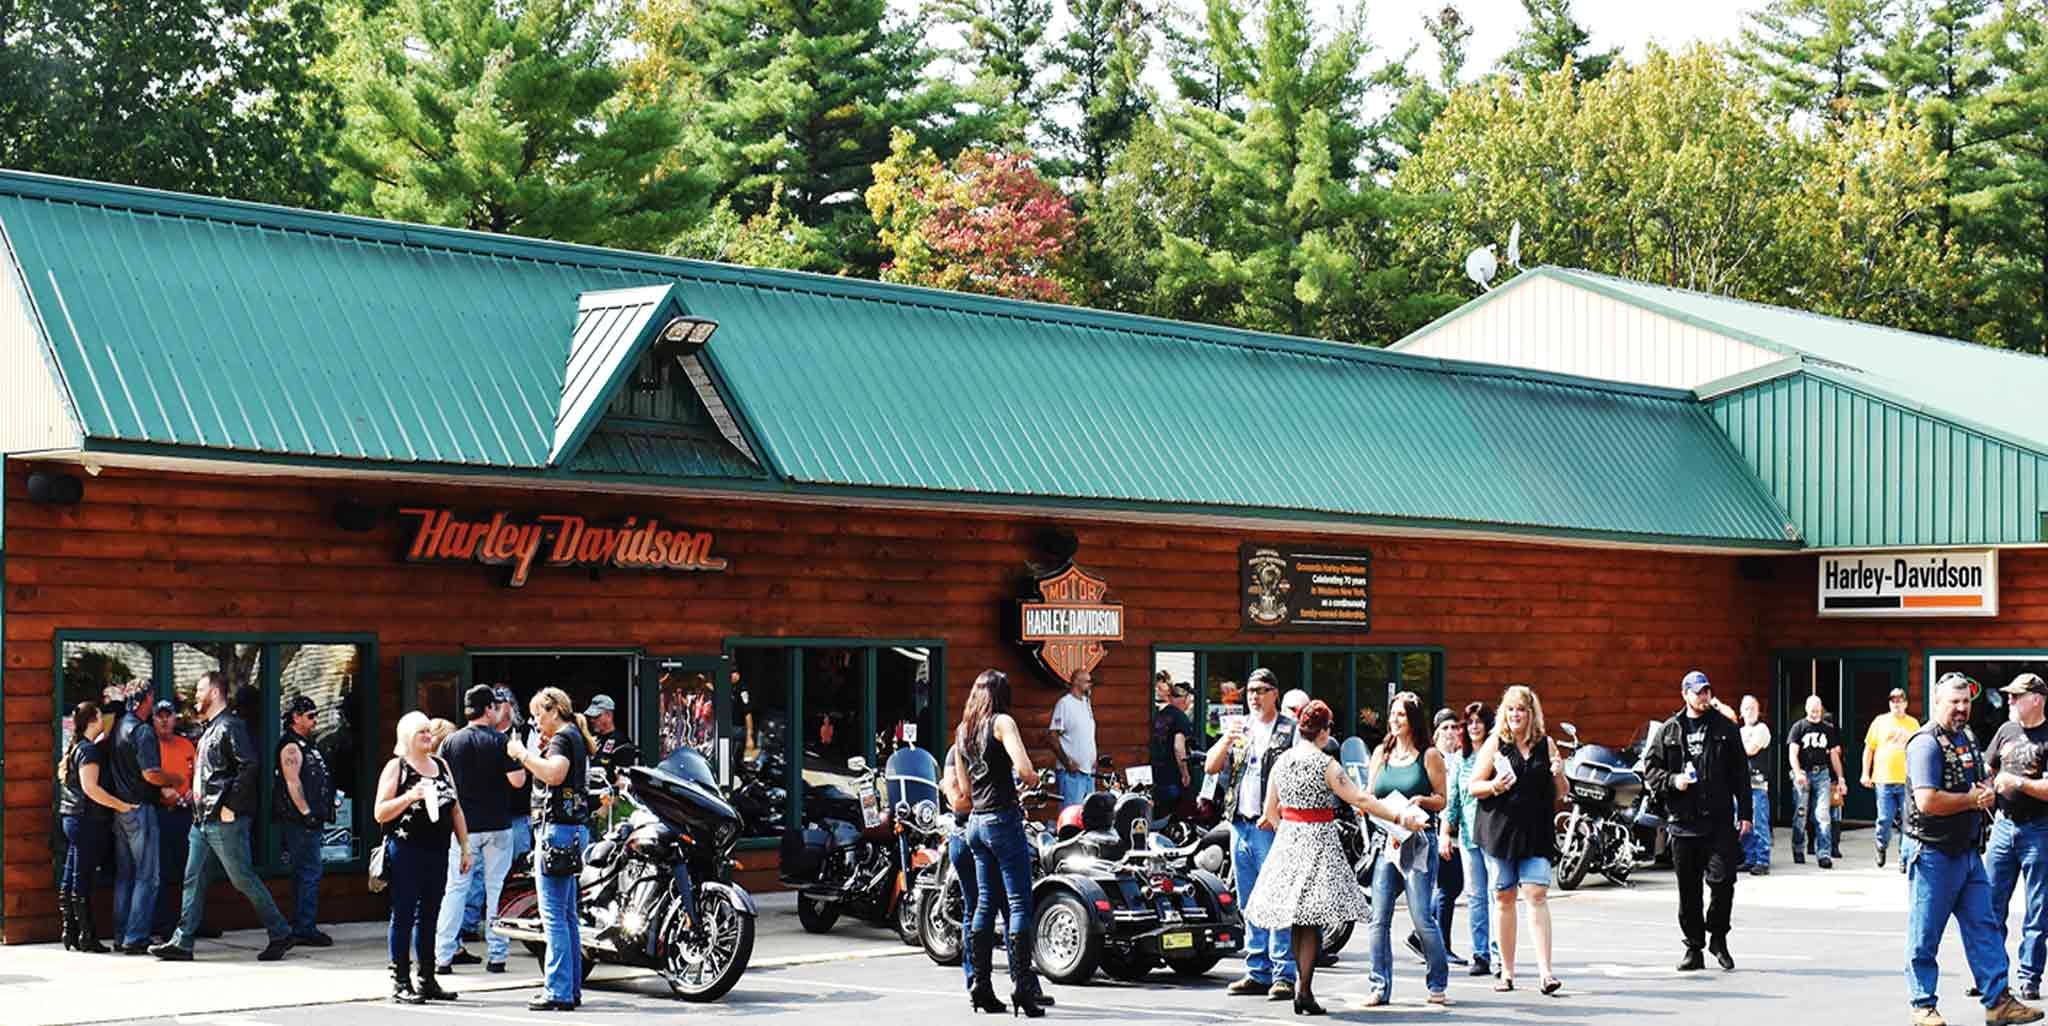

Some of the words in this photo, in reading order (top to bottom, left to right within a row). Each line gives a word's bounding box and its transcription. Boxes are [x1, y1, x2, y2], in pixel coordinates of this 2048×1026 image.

[399, 508, 727, 587] Harley-Davidson
[1044, 574, 1101, 600] MOTOR
[1312, 574, 1343, 586] Celebrating
[1344, 575, 1351, 585] 70
[1352, 578, 1366, 587] years
[1825, 558, 1982, 595] Harley-Davidson
[1333, 599, 1366, 609] continuously
[1026, 609, 1119, 635] HARLEY-DAVIDSON
